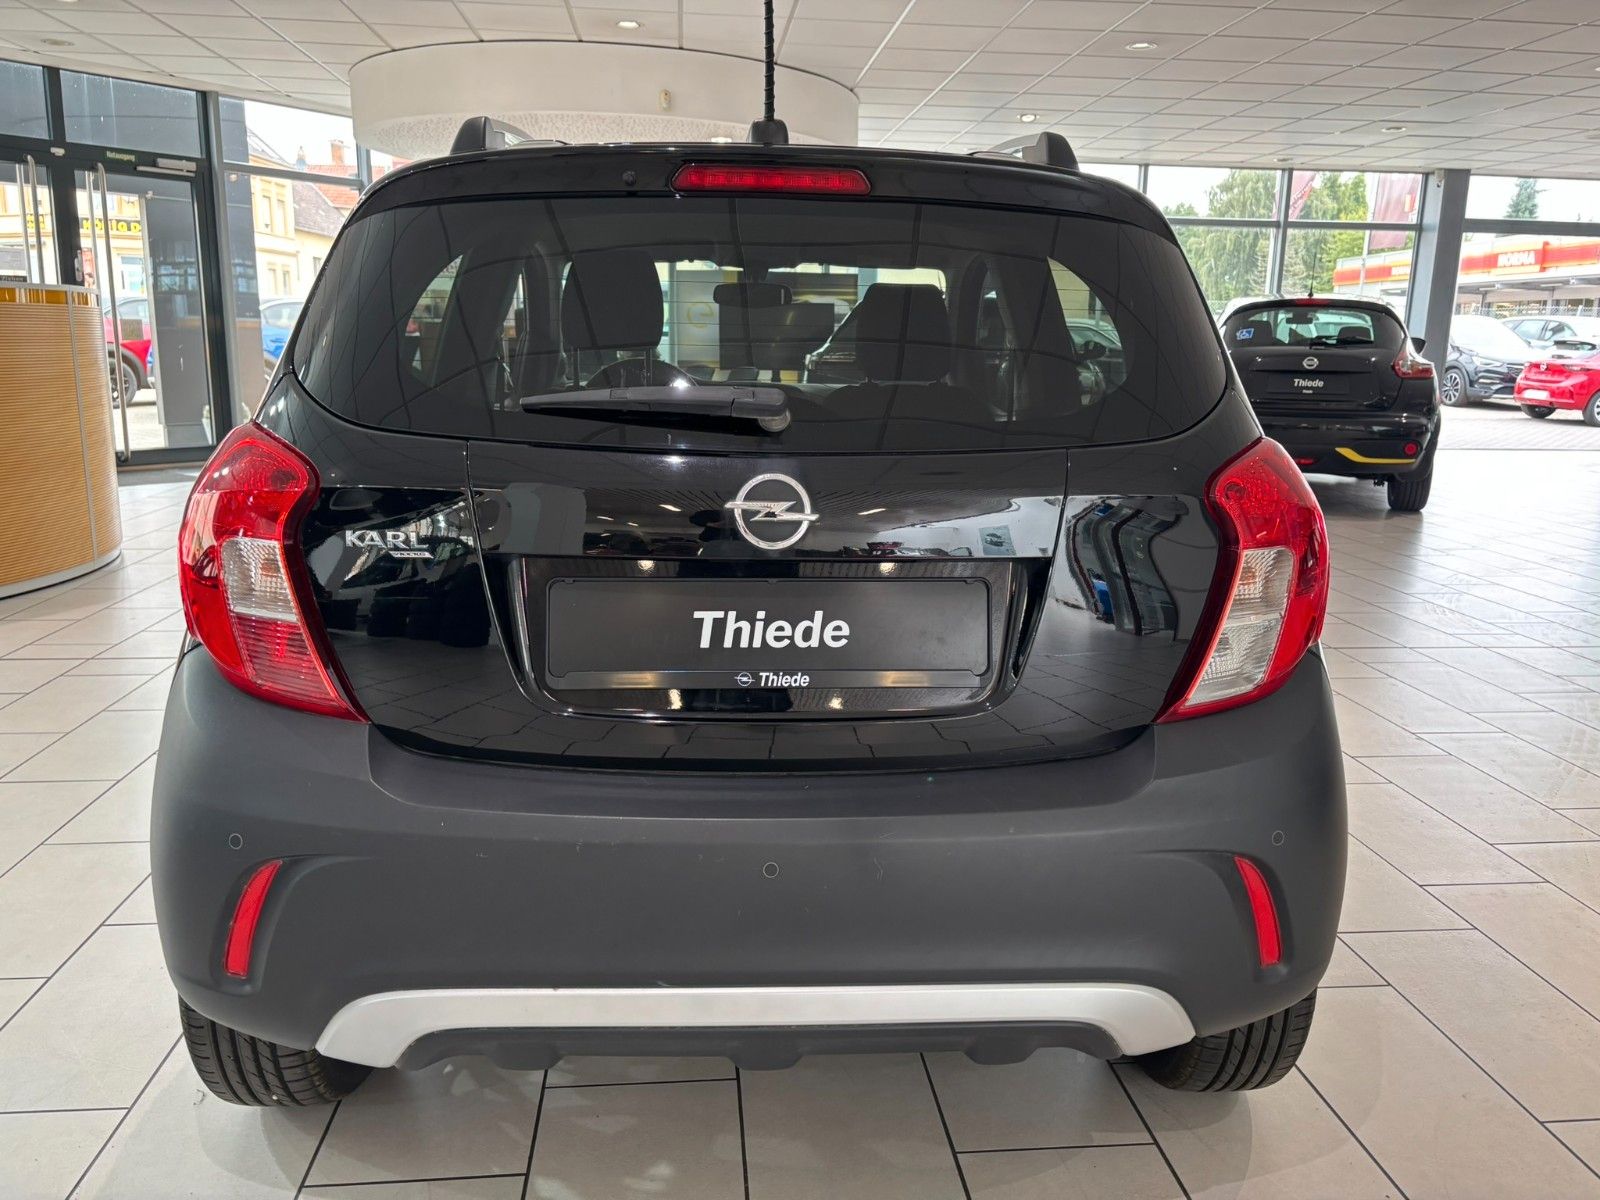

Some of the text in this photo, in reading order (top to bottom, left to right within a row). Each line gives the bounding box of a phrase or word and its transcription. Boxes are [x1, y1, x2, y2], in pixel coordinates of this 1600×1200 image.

[1293, 378, 1324, 388] Thiede
[345, 529, 430, 549] KARL
[693, 610, 851, 649] Thiede
[758, 671, 811, 688] Thiede
